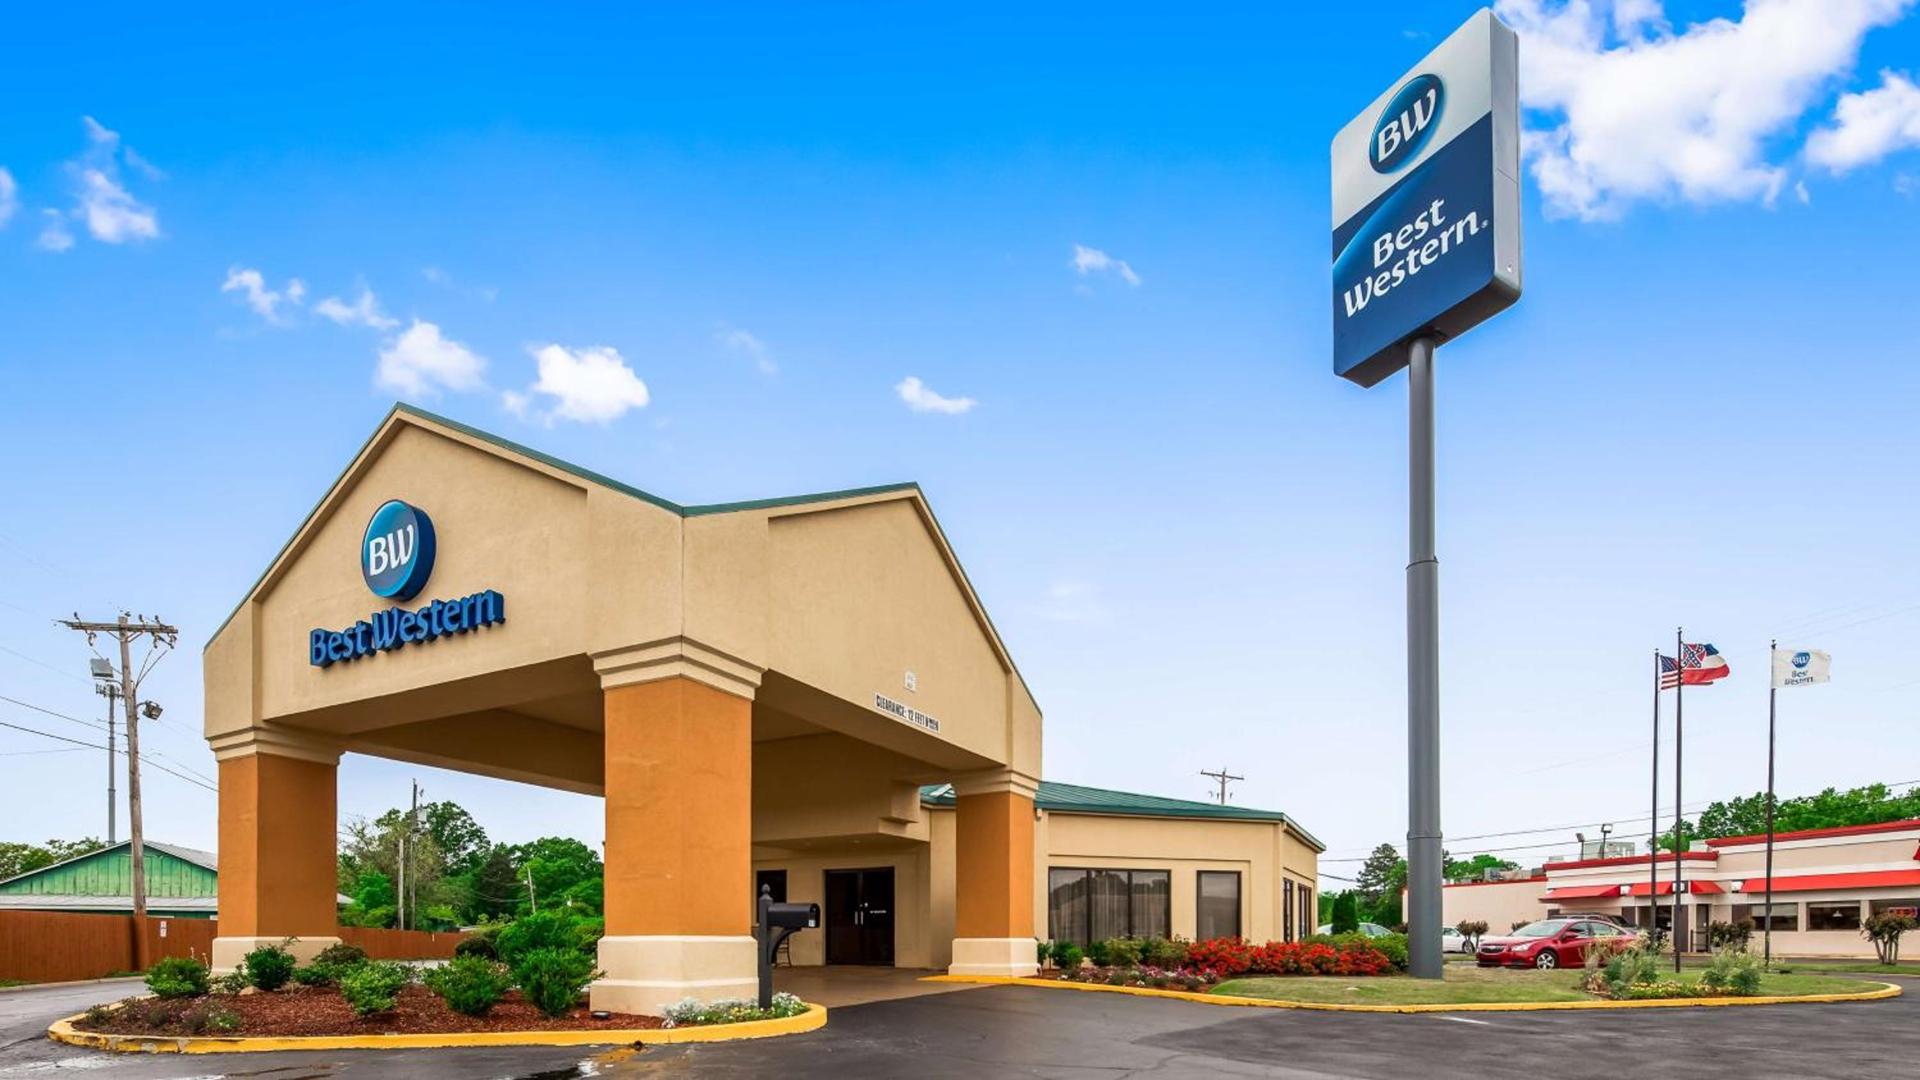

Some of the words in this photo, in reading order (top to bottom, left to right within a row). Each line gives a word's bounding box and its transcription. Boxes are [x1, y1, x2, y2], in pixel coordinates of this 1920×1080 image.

[1378, 88, 1437, 163] BW
[1343, 211, 1479, 318] Western
[1373, 197, 1446, 269] Best
[369, 524, 415, 577] BW
[310, 620, 376, 667] Best
[371, 589, 505, 650] Western
